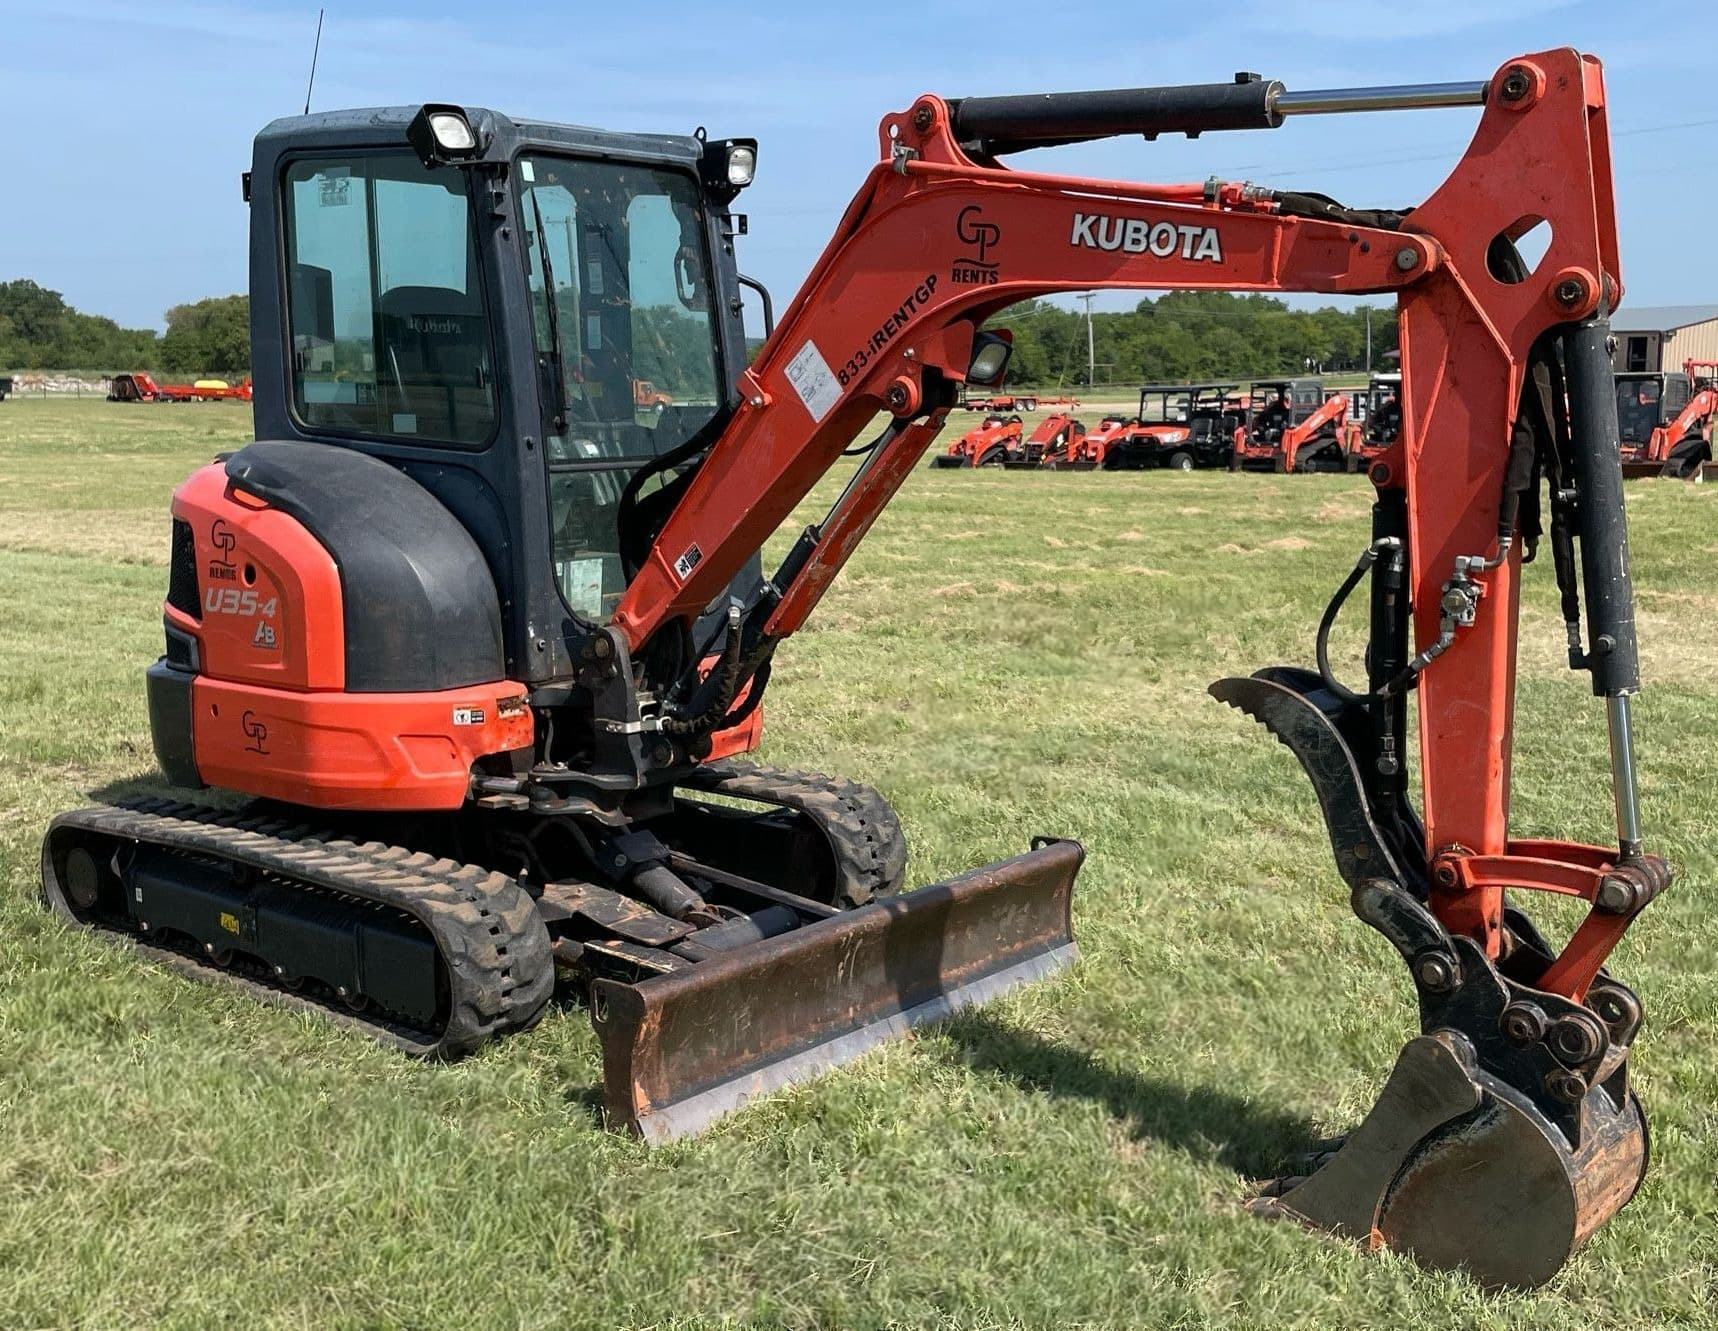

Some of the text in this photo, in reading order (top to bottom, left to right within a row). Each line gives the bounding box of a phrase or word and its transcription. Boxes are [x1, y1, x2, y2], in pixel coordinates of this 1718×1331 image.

[1070, 212, 1223, 264] KUBOTA
[952, 267, 999, 285] RENTS
[838, 273, 938, 386] 833-iRENTGP
[205, 587, 277, 618] U35-4
